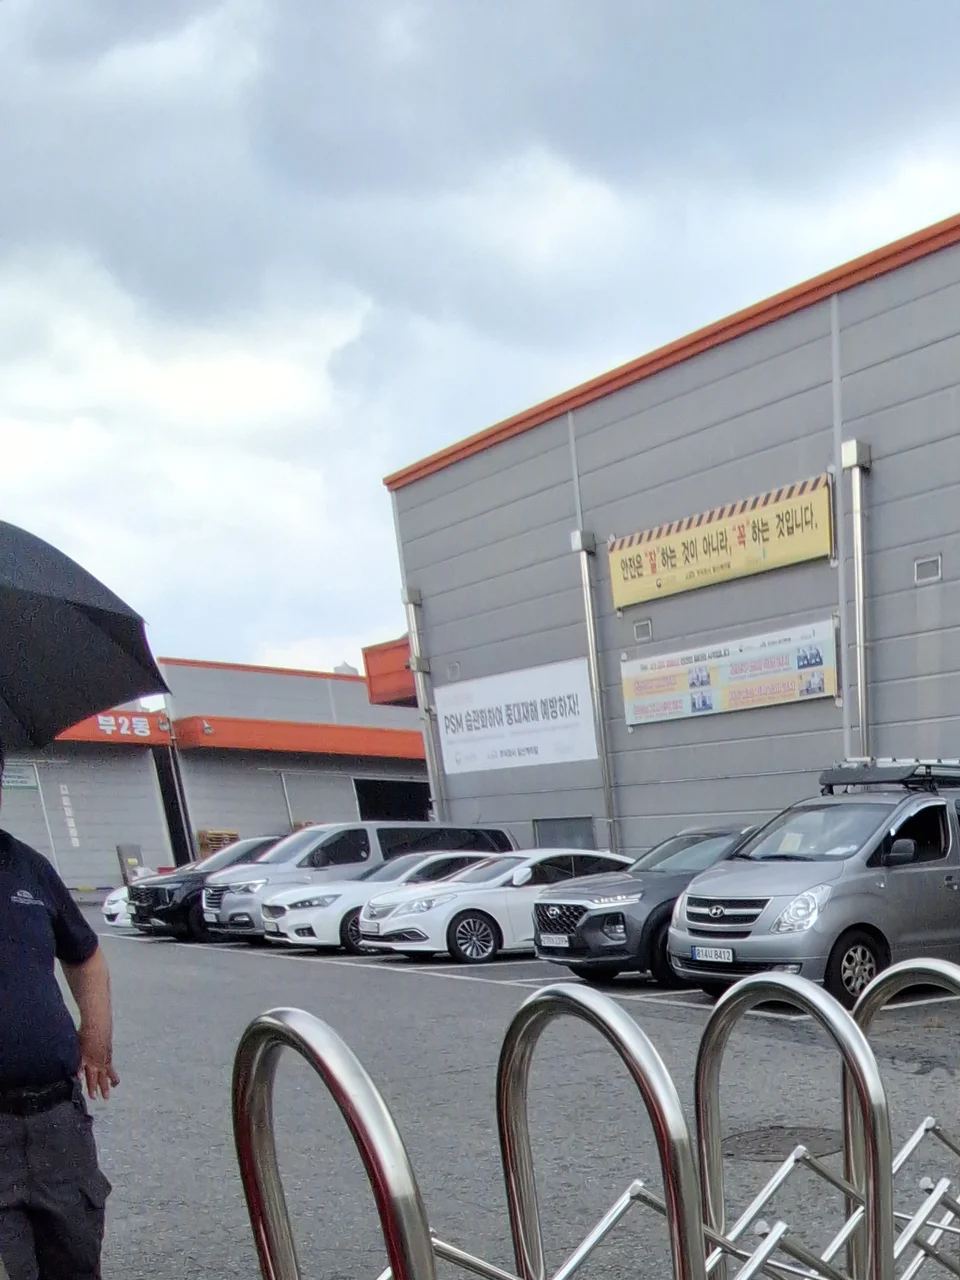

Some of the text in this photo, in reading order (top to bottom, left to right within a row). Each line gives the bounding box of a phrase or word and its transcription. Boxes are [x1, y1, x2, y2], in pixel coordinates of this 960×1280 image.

[620, 553, 644, 581] 안전은
[682, 537, 698, 564] 것이
[776, 502, 818, 538] 것입니다.
[444, 713, 464, 735] PSM
[465, 706, 504, 732] 습관화하여
[505, 699, 539, 726] 중대재해
[540, 693, 580, 721] 예방하자!
